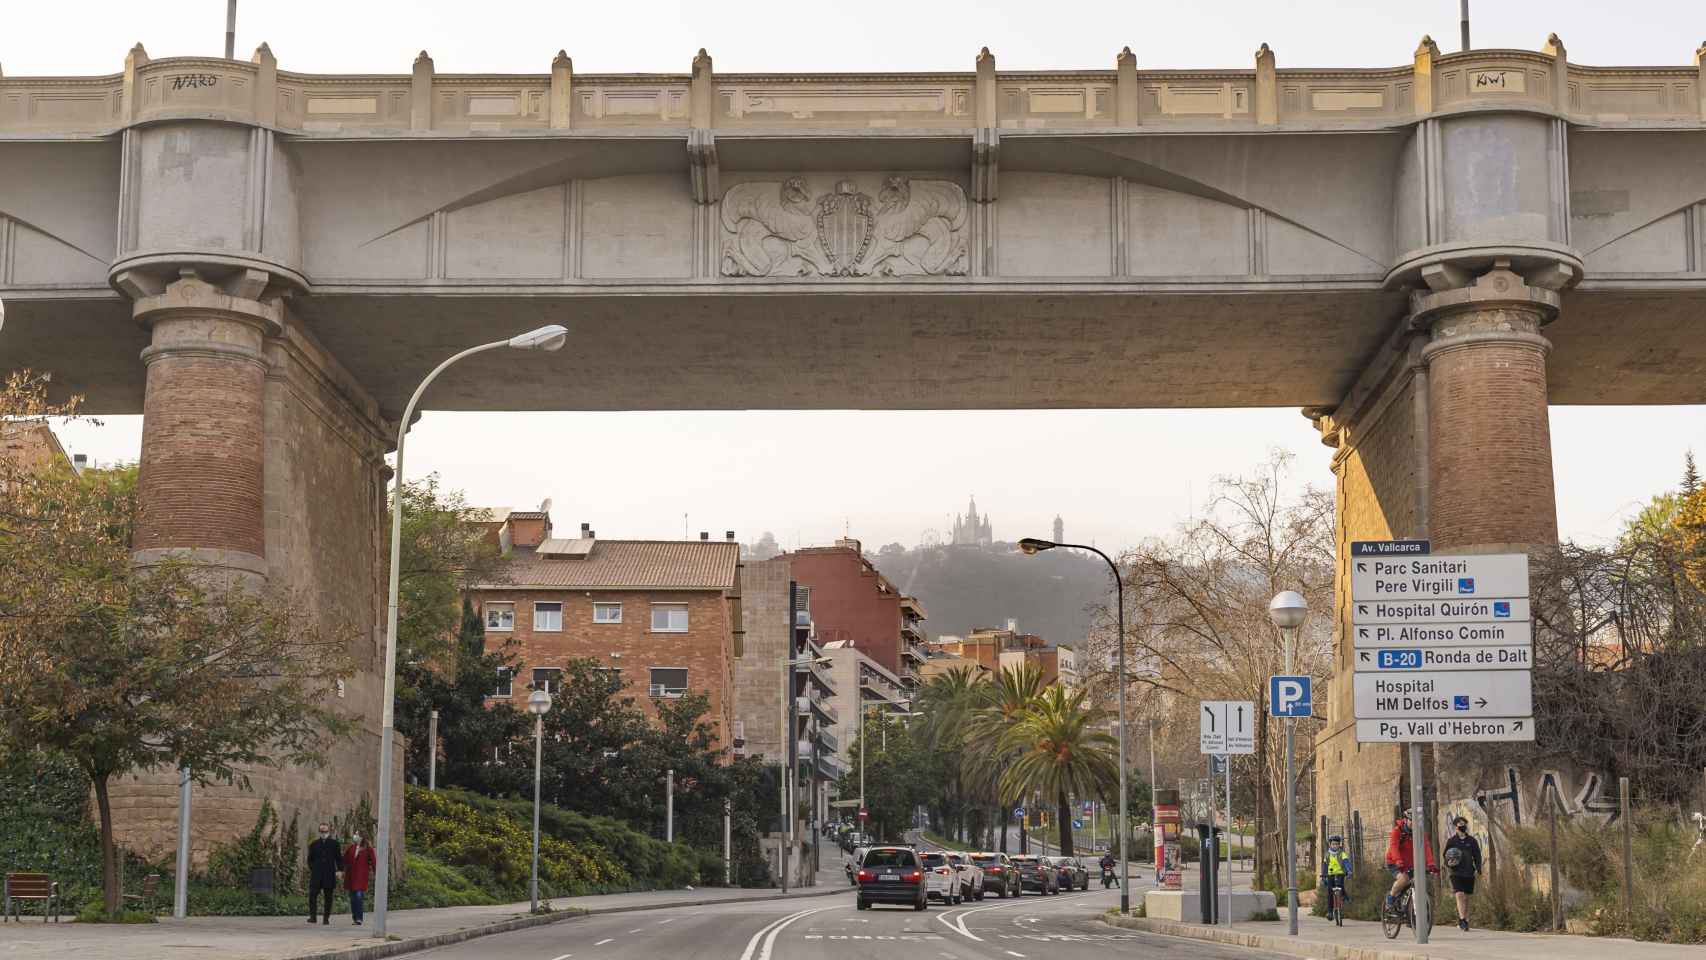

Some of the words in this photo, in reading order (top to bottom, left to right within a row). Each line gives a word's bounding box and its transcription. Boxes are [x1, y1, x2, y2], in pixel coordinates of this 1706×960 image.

[1361, 544, 1376, 552] Av.
[1378, 543, 1421, 552] Vallcarca
[1375, 562, 1407, 575] Parc
[1412, 560, 1467, 574] Sanitari
[1376, 580, 1407, 593] Pere
[1412, 579, 1453, 595] Virgili
[1376, 604, 1435, 619] Hospital
[1440, 603, 1488, 617] Quirón
[1377, 628, 1394, 641] Pl.
[1399, 627, 1453, 640] Alfonso
[1383, 652, 1417, 666] B-20
[1425, 651, 1471, 664] Ronda
[1476, 650, 1493, 663] de
[1499, 649, 1528, 662] Dalt
[1376, 680, 1434, 695] Hospital
[1278, 681, 1303, 712] P
[1376, 697, 1399, 711] HM
[1403, 696, 1449, 710] Delfos
[1380, 723, 1402, 738] Pg.
[1407, 722, 1433, 736] Vall
[1438, 722, 1505, 736] d'Hebron
